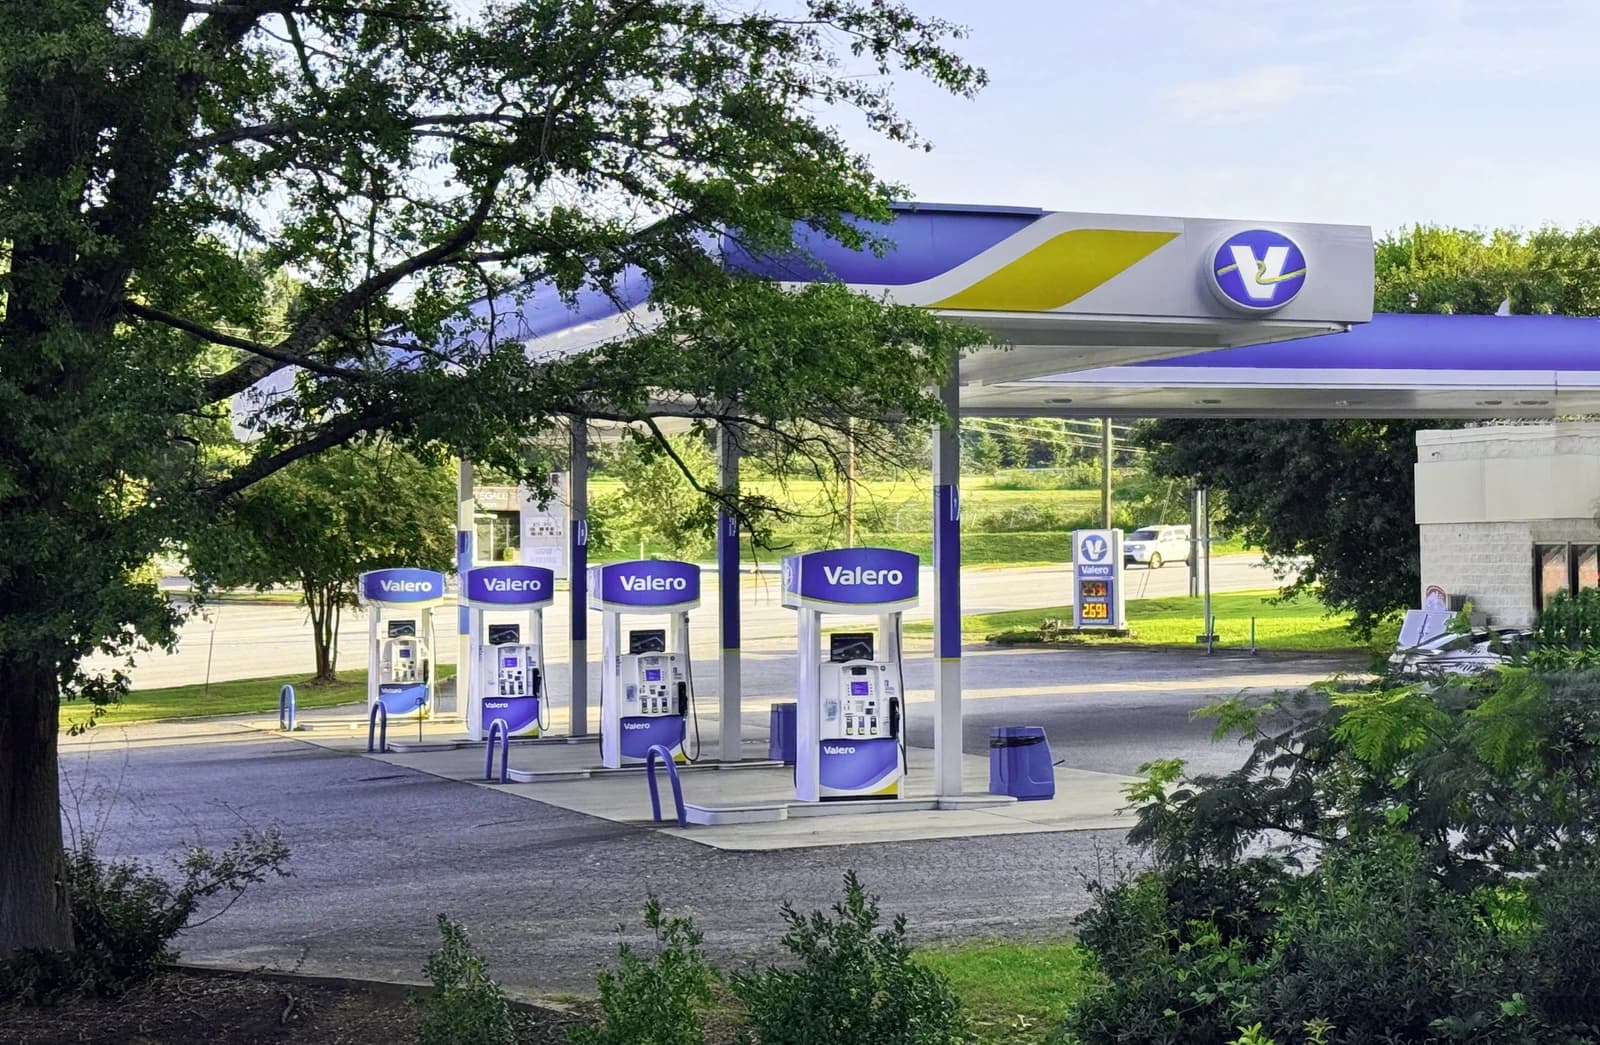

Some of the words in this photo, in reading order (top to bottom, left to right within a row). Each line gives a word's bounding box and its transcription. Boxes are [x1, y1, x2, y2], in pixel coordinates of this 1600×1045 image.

[1230, 245, 1290, 299] V
[823, 566, 903, 586] Valero
[1081, 565, 1109, 575] Valero
[380, 579, 432, 593] Valero
[483, 578, 542, 592] Valero
[620, 575, 687, 591] Valero
[624, 722, 650, 730] Valero
[823, 746, 856, 755] Valero
